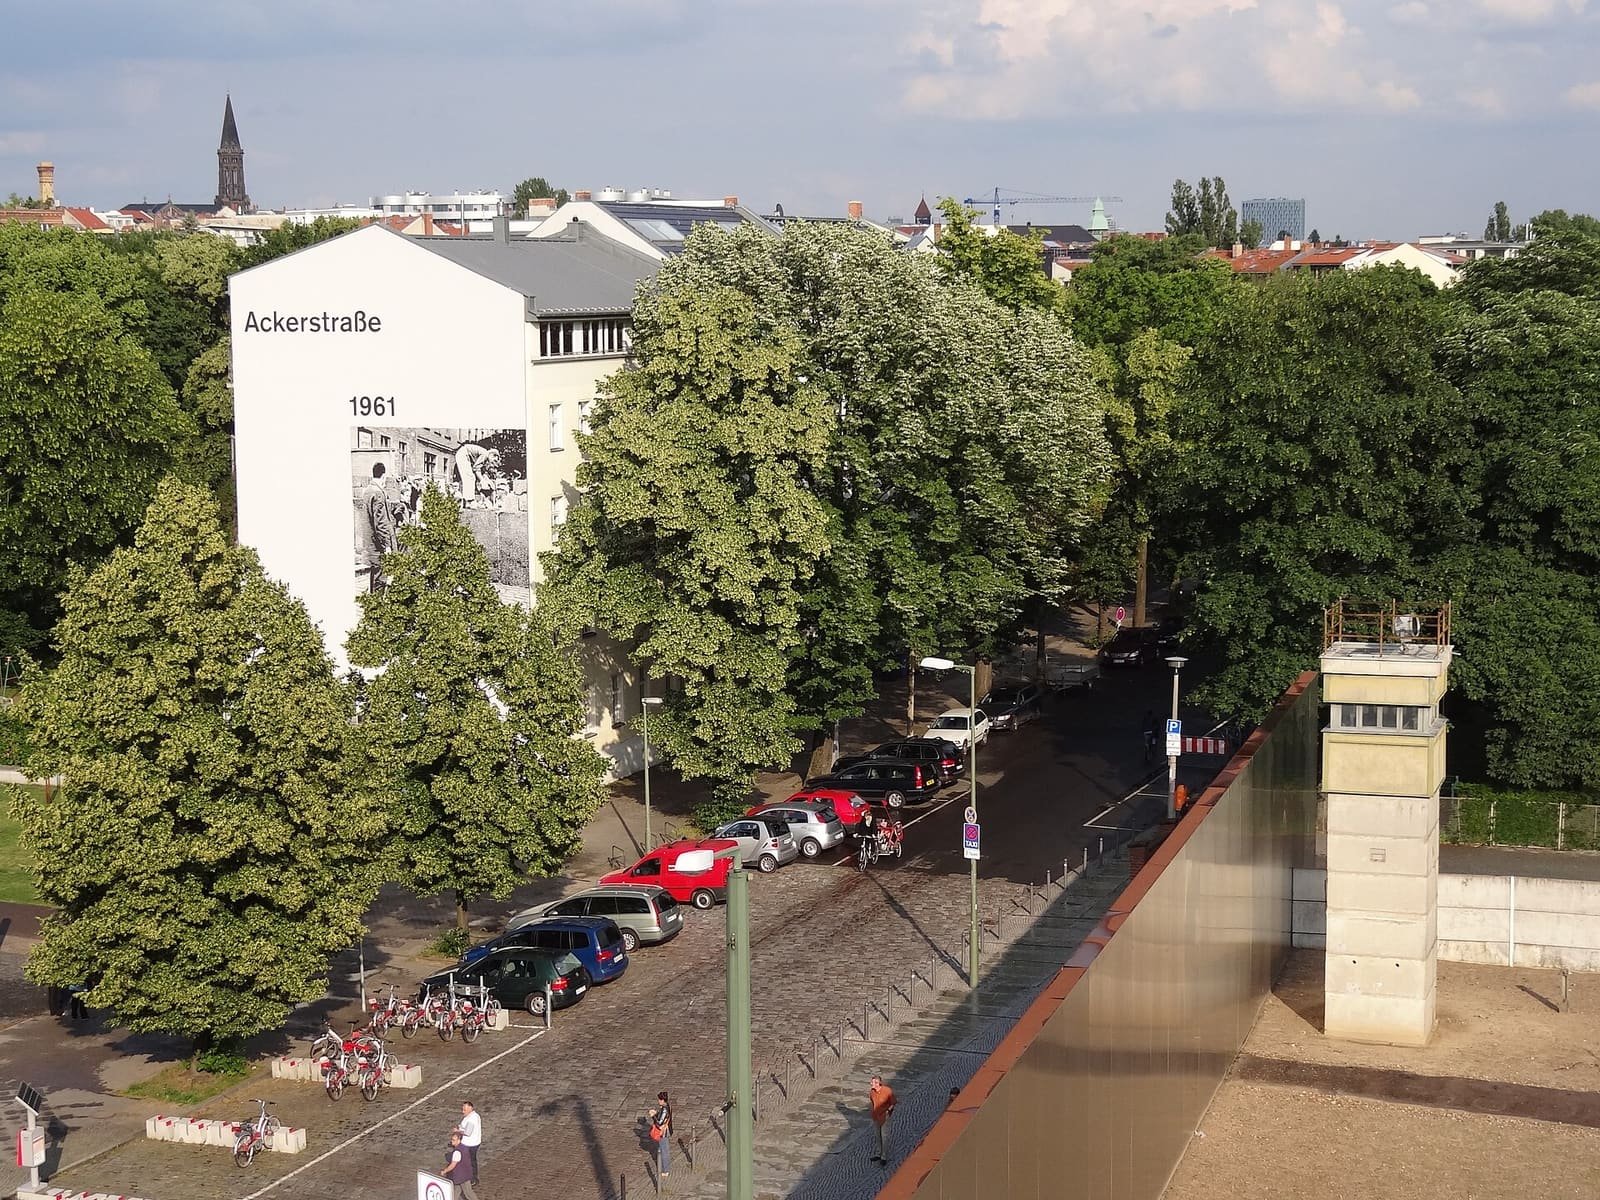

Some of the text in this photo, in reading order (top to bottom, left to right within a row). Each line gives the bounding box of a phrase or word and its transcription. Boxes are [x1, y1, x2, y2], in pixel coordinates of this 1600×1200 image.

[244, 310, 382, 333] Ackerstraße
[349, 396, 396, 417] 1961
[1169, 721, 1178, 731] P
[966, 840, 977, 848] TAXI
